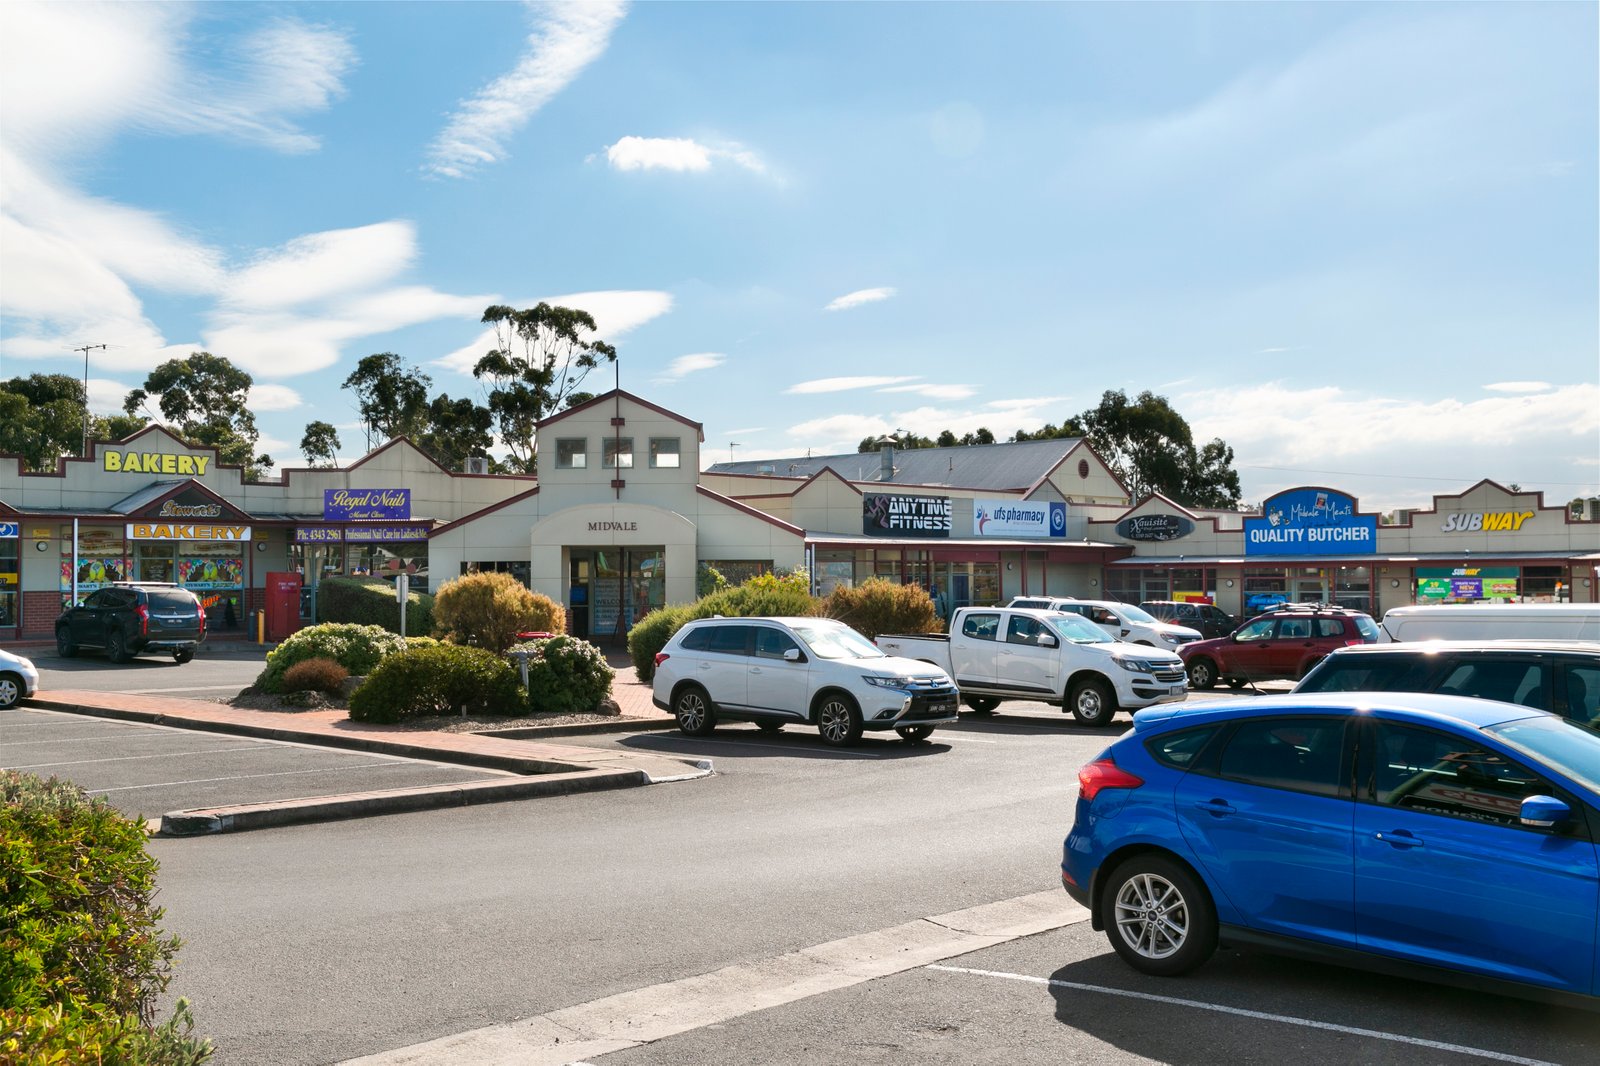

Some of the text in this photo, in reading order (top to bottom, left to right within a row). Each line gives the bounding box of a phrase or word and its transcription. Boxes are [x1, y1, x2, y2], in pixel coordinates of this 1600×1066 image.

[104, 450, 210, 475] BAKERY
[329, 489, 405, 511] Regal Nails
[888, 496, 953, 516] ANYTIME
[993, 506, 1046, 524] ufs pharmacy
[1324, 501, 1352, 520] Meats
[588, 522, 638, 531] MIDVALE
[889, 515, 953, 530] FITNESS
[1130, 517, 1168, 533] Xquisite
[1441, 511, 1535, 532] SUBWAY
[133, 524, 245, 539] BAKERY
[297, 529, 309, 540] Ph:
[309, 529, 325, 540] 4343
[345, 528, 372, 539] Professional
[372, 528, 383, 539] Nail
[383, 528, 394, 539] Care
[1250, 527, 1370, 543] QUALITY BUTCHER
[1451, 568, 1481, 576] SUBWAY
